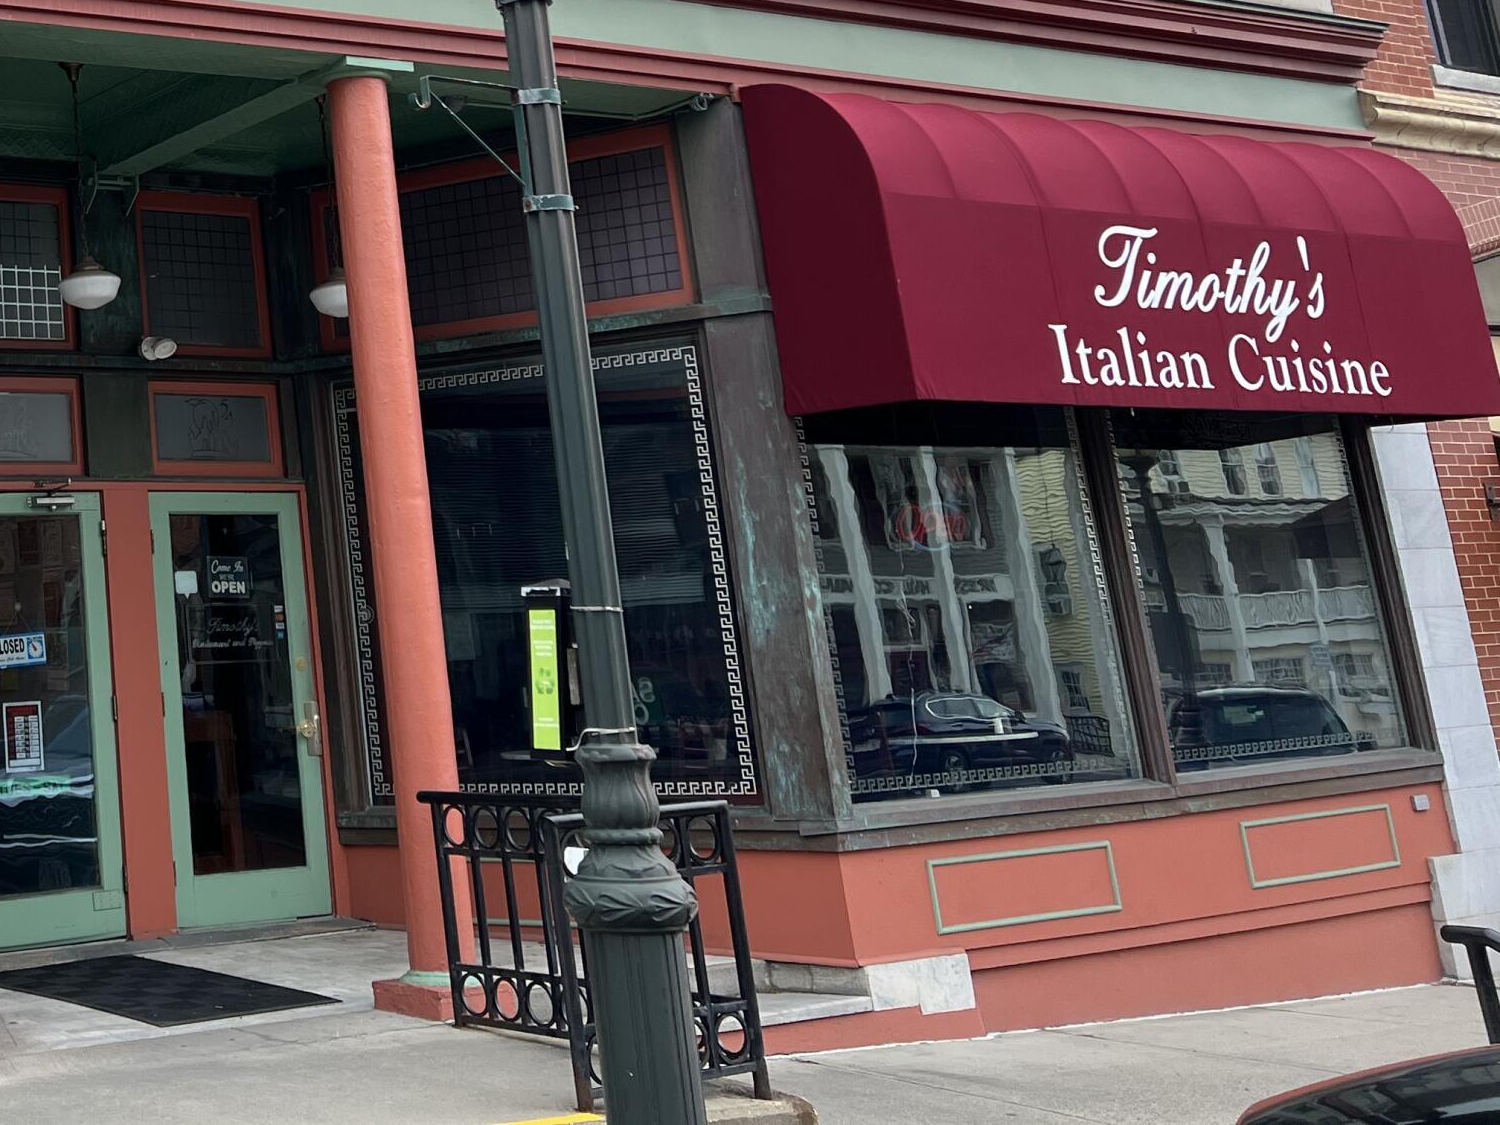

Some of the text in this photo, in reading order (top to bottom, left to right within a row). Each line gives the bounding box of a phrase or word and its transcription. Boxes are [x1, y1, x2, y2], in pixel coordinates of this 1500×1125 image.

[1094, 225, 1325, 343] Timothy's
[1048, 324, 1393, 396] Italian Cuisine
[210, 559, 232, 574] Come
[211, 581, 246, 594] OPEN
